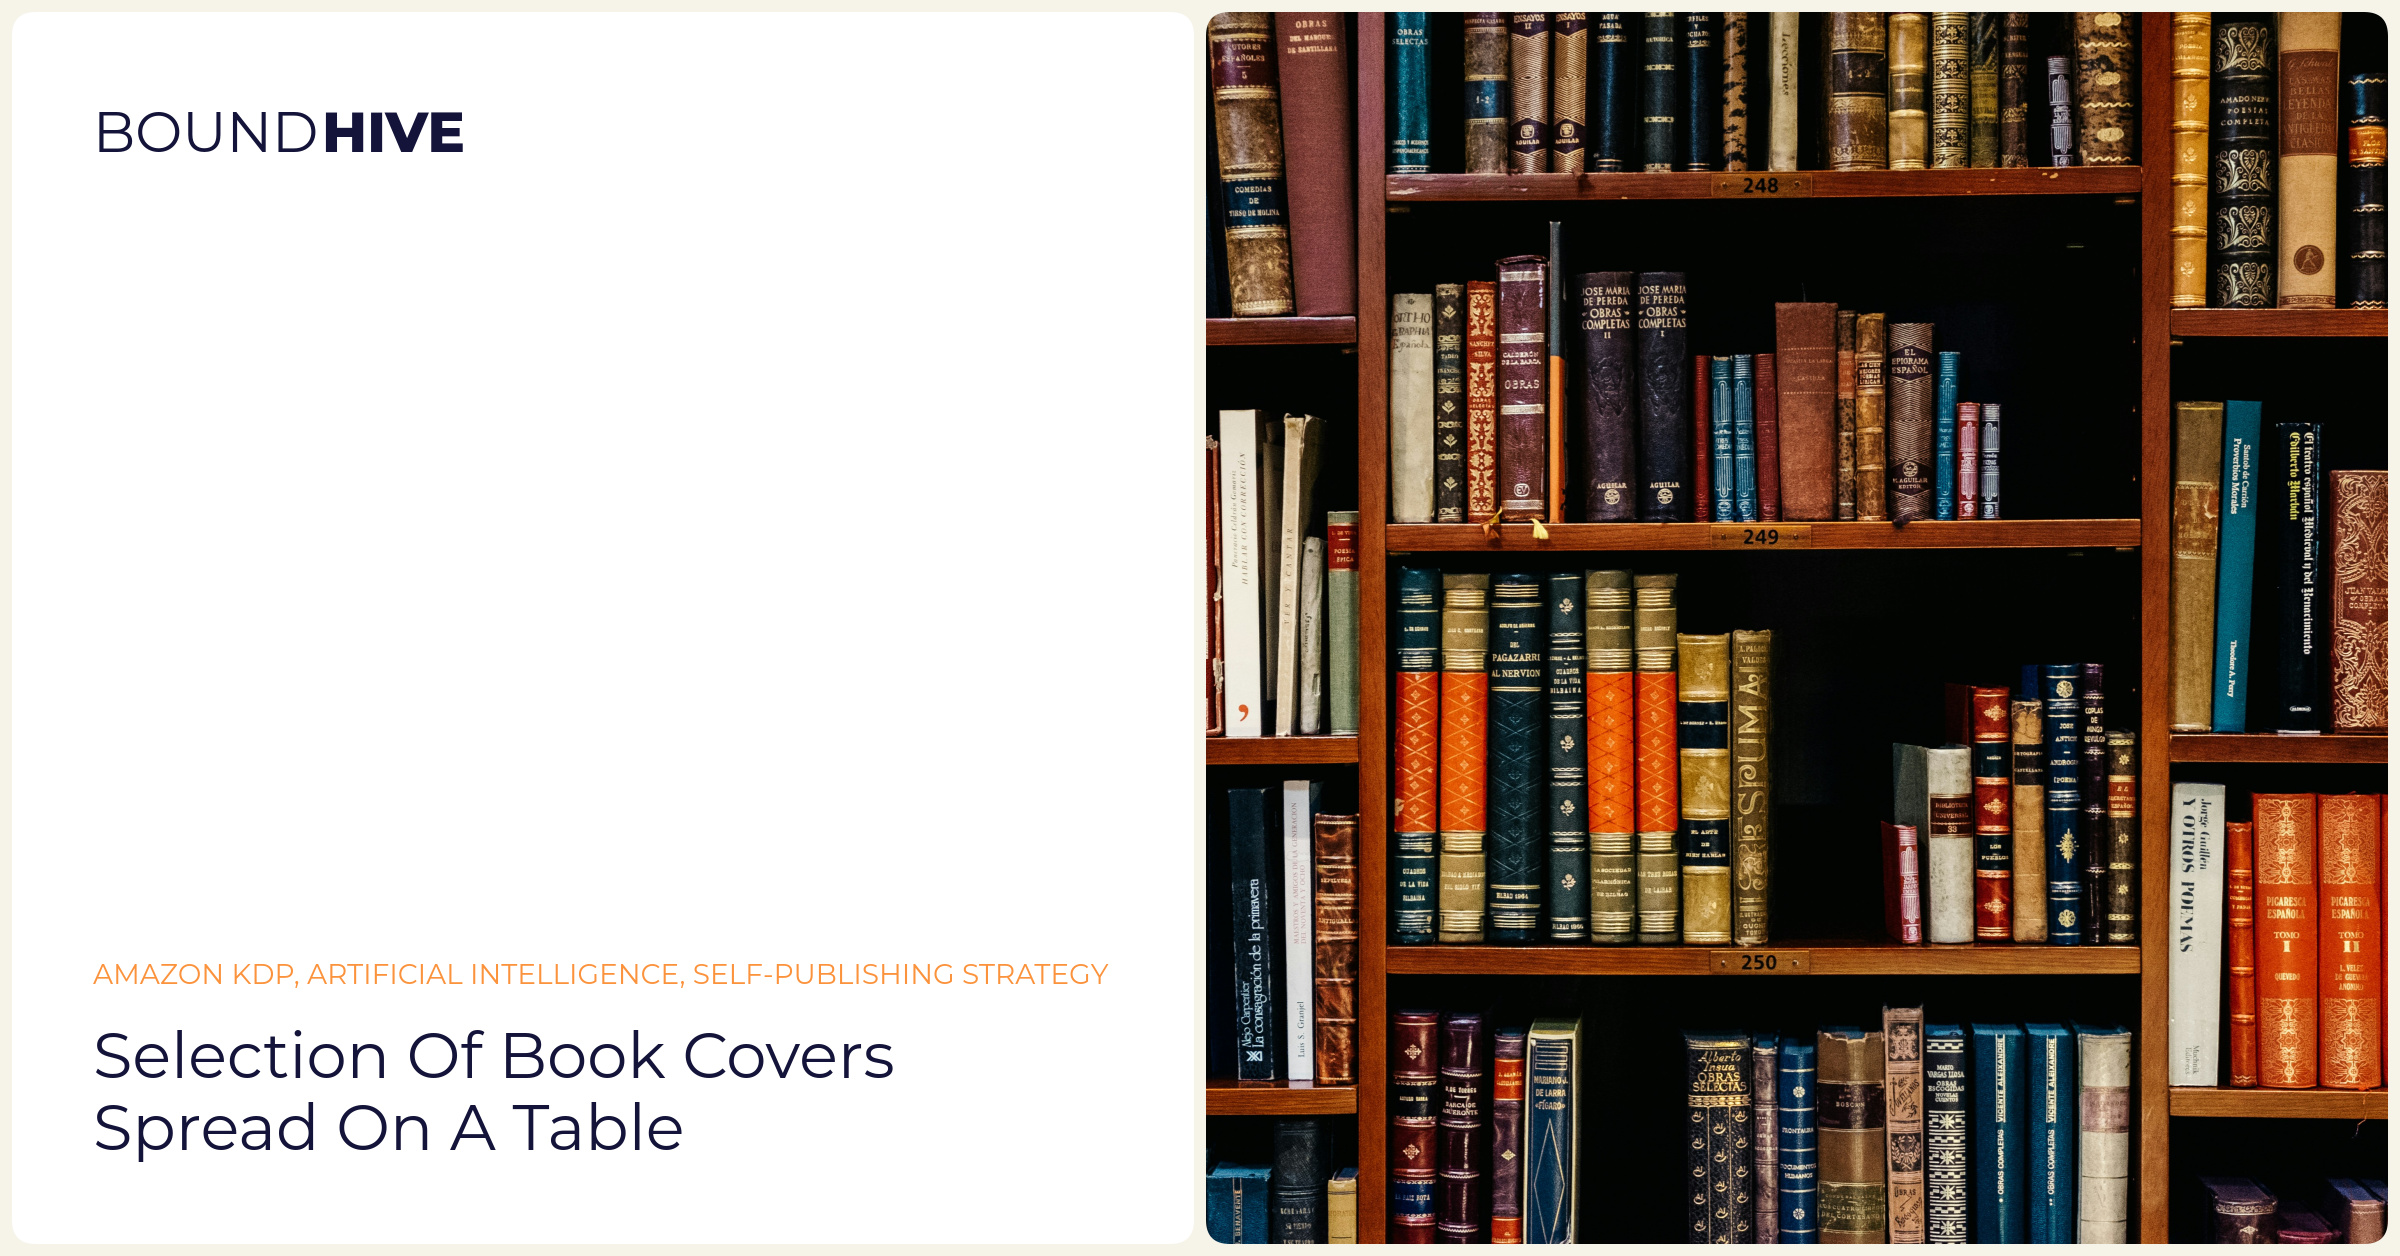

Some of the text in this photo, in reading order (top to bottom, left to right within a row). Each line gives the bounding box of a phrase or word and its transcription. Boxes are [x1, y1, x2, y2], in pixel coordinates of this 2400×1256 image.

[1514, 14, 1545, 23] ENSAYOS
[1556, 13, 1586, 22] ENSAYOS
[1295, 20, 1328, 28] OBRAS
[1391, 37, 1428, 45] SELECTAS
[1743, 177, 1779, 193] 248
[1581, 286, 1630, 297] JOSE MARIA
[1638, 285, 1687, 295] JOSE MARIA
[1583, 297, 1628, 306] DE PEREDA
[1640, 295, 1685, 304] DE PEREDA
[1589, 308, 1622, 319] OBRAS
[1646, 307, 1678, 317] OBRAS
[1582, 319, 1630, 330] COMPLETAS
[1638, 318, 1687, 329] COMPLETAS
[1904, 348, 1916, 356] EL
[1892, 365, 1929, 374] ESPAÑOL
[1504, 380, 1540, 389] OBRAS
[2303, 446, 2313, 475] teatro
[2230, 437, 2242, 515] Proverbios Morales
[2240, 444, 2251, 509] Santob de Carrión
[1237, 452, 1247, 518] CORRECCIÓN
[1649, 481, 1680, 489] AGUILAR
[1743, 529, 1779, 545] 249
[1285, 528, 1293, 577] CANTAR
[1240, 544, 1248, 585] HABLAR
[1492, 653, 1541, 662] PAGAZARRI
[1491, 669, 1541, 677] AL NERVION
[1947, 825, 1958, 833] 33
[2198, 798, 2212, 870] Jorge Guillén
[2179, 798, 2196, 953] Y OTROS POEMAS
[2266, 896, 2306, 907] PICARESCA
[2331, 896, 2370, 907] PICARESCA
[2267, 908, 2305, 919] ESPAÑOLA
[2331, 908, 2369, 919] ESPAÑOLA
[2273, 931, 2300, 939] TOMO
[2338, 931, 2364, 939] TOMO
[2282, 940, 2291, 953] I
[2343, 940, 2361, 953] II
[1248, 879, 1268, 1048] La consagración de la primavera
[1741, 954, 1777, 970] 250
[2274, 972, 2301, 981] QUEVEDO
[1241, 981, 1253, 1048] Alejo Carpentier
[1698, 1051, 1742, 1062] Alberto
[1703, 1062, 1736, 1072] Insua
[1996, 1038, 2004, 1087] ALEIXANDRE
[1533, 1076, 1562, 1084] MARIANO
[1697, 1072, 1741, 1082] OBRAS
[1927, 1071, 1947, 1079] VARGAS
[1692, 1081, 1747, 1092] SELECTAS
[1535, 1089, 1566, 1097] DE LARRA
[2047, 1089, 2055, 1123] VICENTE
[2047, 1129, 2055, 1195] OBRAS COMPLETAS
